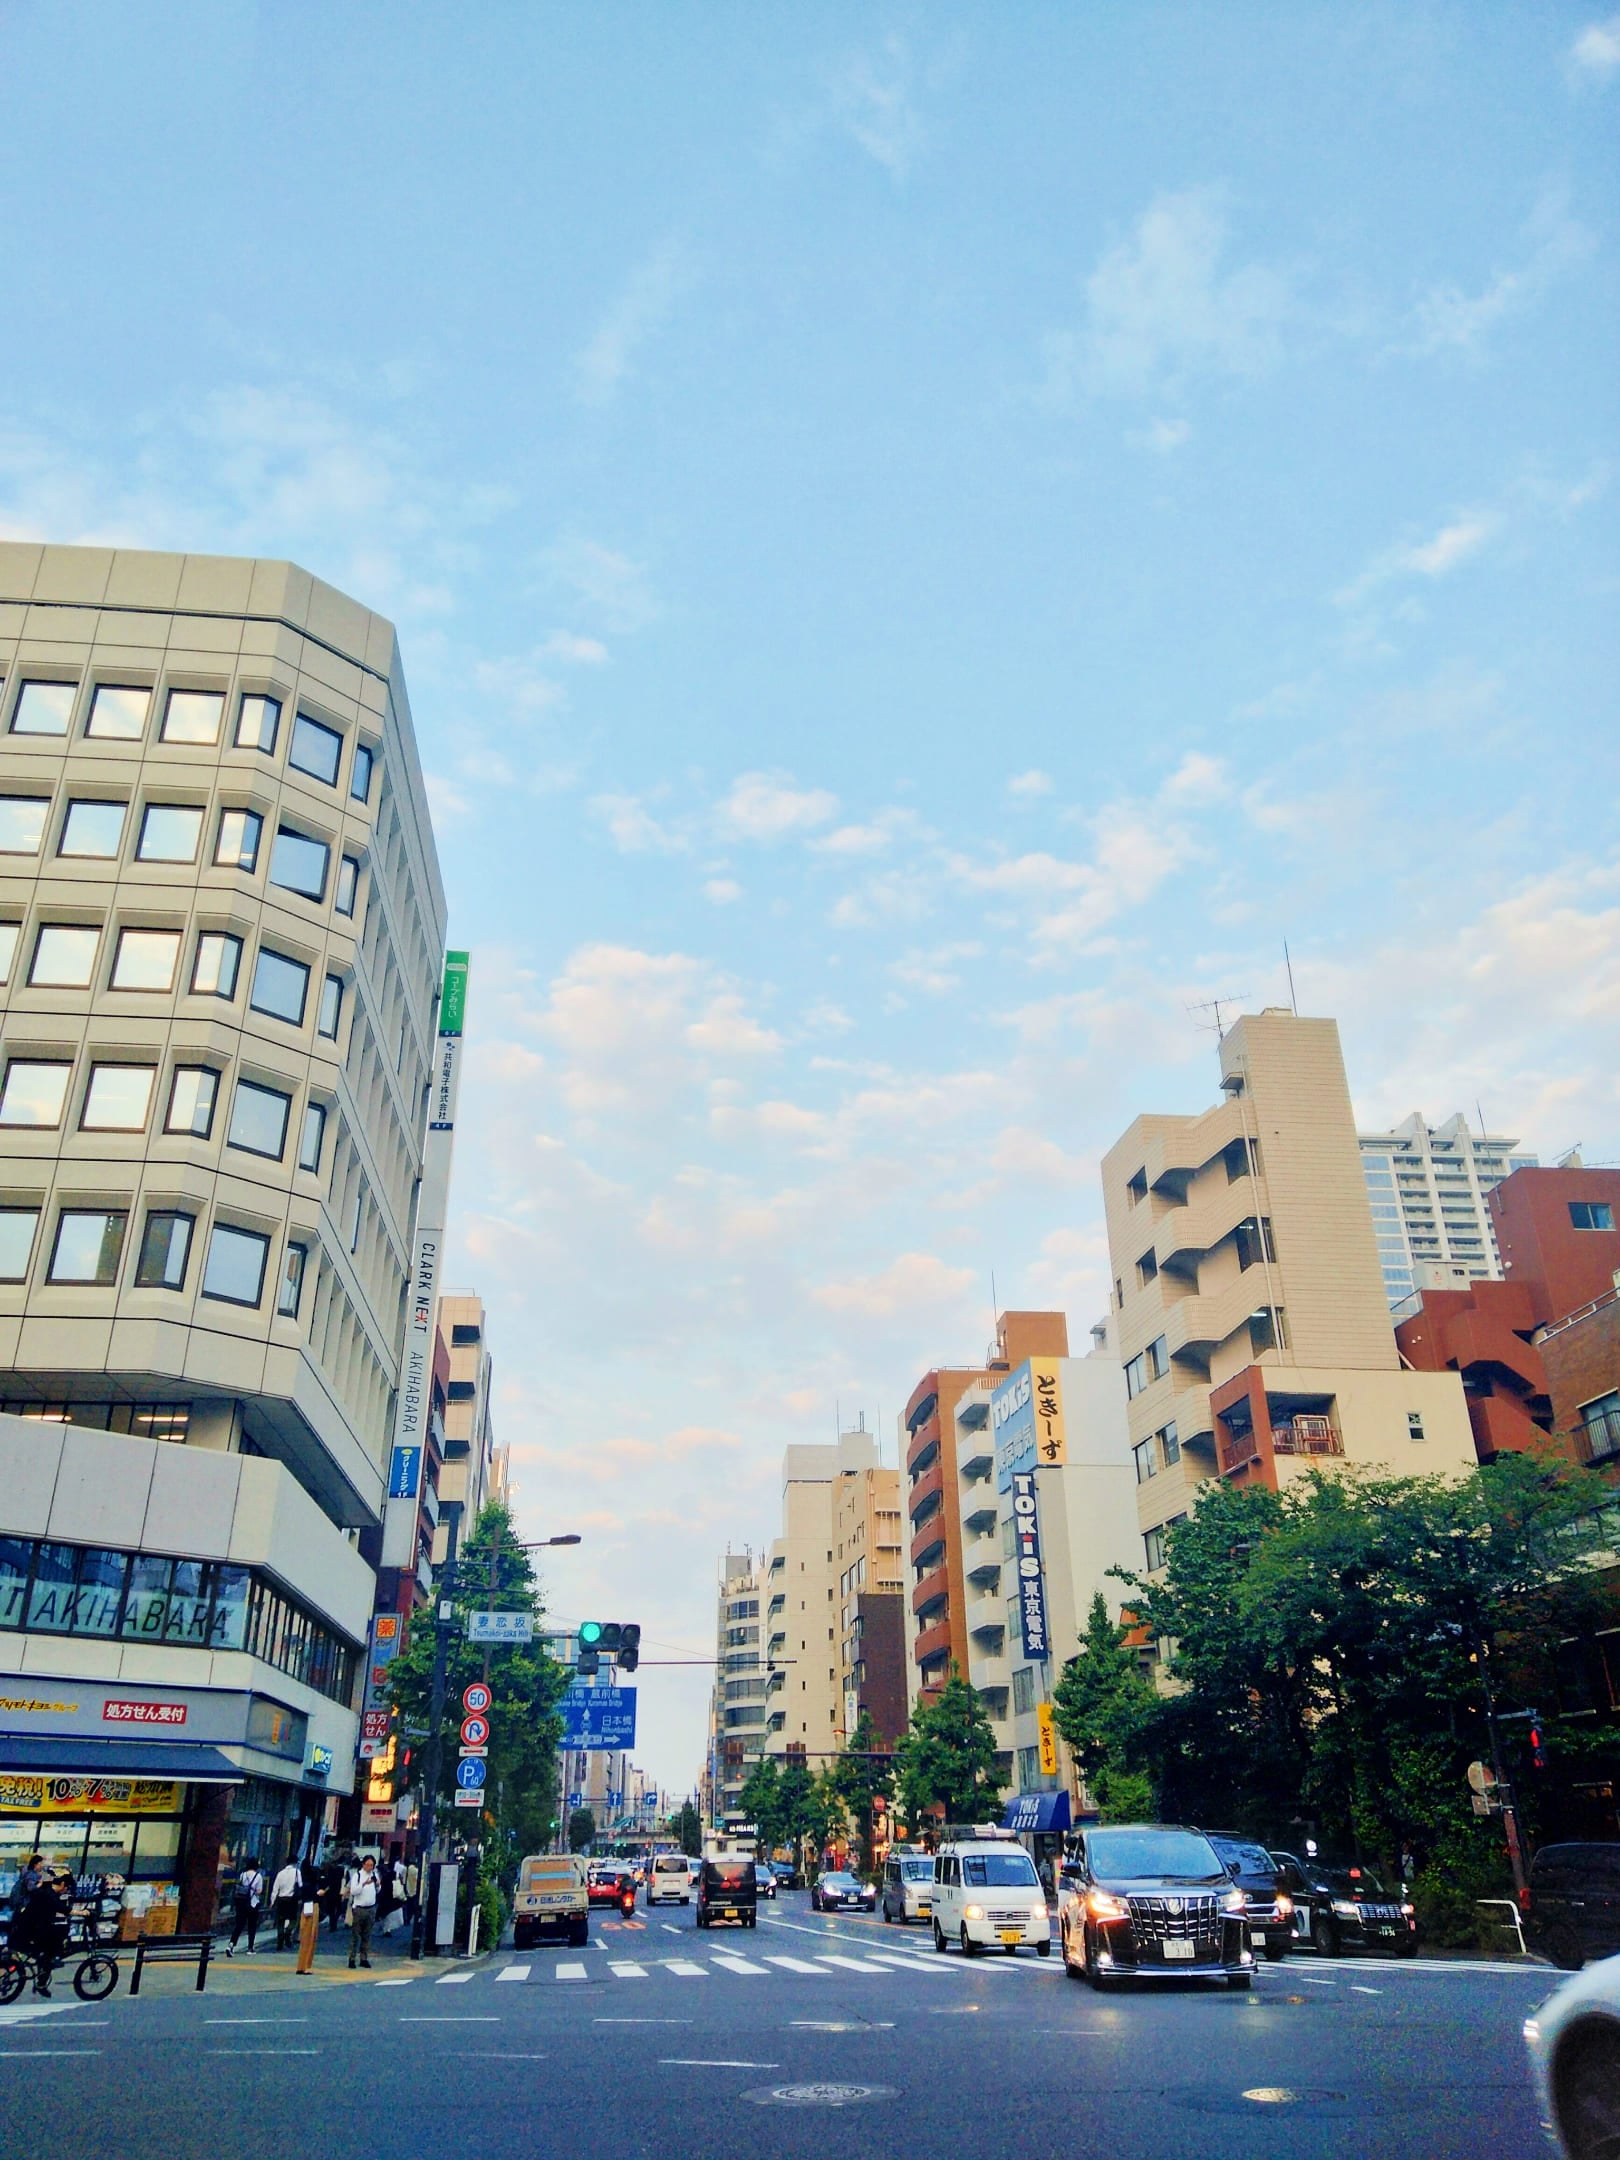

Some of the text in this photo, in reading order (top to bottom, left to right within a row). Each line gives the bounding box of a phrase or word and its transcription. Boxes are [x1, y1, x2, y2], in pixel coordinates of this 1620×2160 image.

[438, 1053, 452, 1120] 共和電子株式会社
[413, 1242, 436, 1333] CLARK NEXT
[402, 1351, 424, 1433] AKIHABARA
[1037, 1374, 1063, 1460] ときーず
[33, 1590, 228, 1639] AKIHABARA
[478, 1616, 526, 1628] 妻恋坂
[1023, 1580, 1044, 1650] 東京電気
[469, 1692, 485, 1706] 50
[106, 1703, 185, 1722] 処方せん受付
[366, 1714, 388, 1725] 処方
[602, 1715, 632, 1726] 日本橋
[365, 1726, 387, 1737] せん
[463, 1766, 475, 1785] P
[470, 1776, 479, 1785] 60
